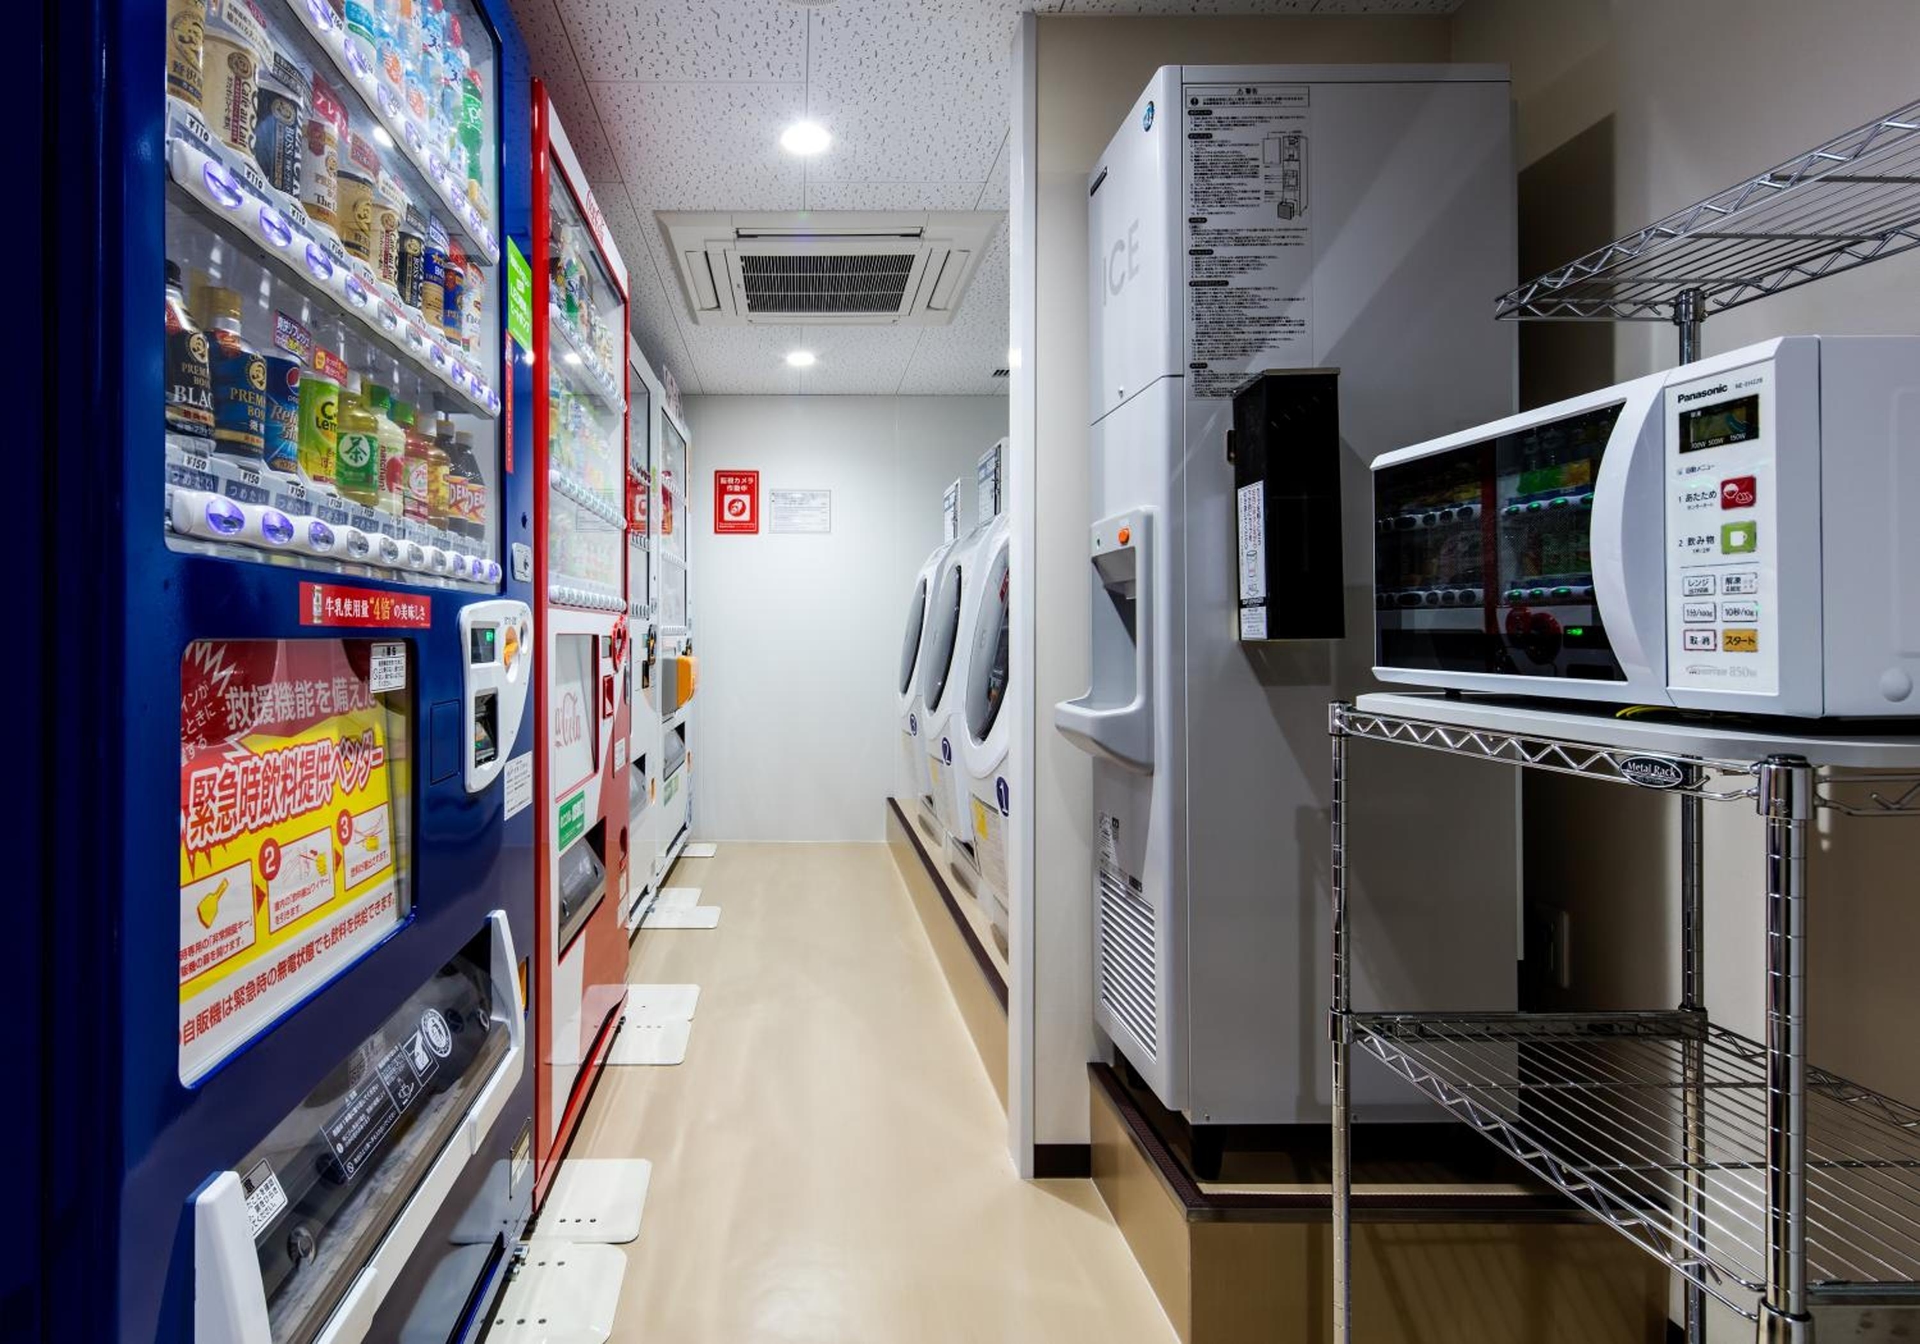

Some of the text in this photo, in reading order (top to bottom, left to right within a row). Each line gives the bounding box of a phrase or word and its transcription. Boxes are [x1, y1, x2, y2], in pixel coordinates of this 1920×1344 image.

[1102, 218, 1140, 307] ICE
[1678, 384, 1728, 403] Panasonic
[186, 456, 207, 471] ¥150
[241, 472, 261, 486] ¥150
[229, 485, 267, 503] つめたい
[1685, 490, 1717, 502] あたため
[1687, 536, 1715, 546] 飲み物
[1688, 579, 1709, 587] レンジ
[1725, 636, 1756, 646] スタート
[942, 741, 952, 764] 2
[1627, 761, 1677, 778] Metal Rack
[265, 847, 276, 874] 2
